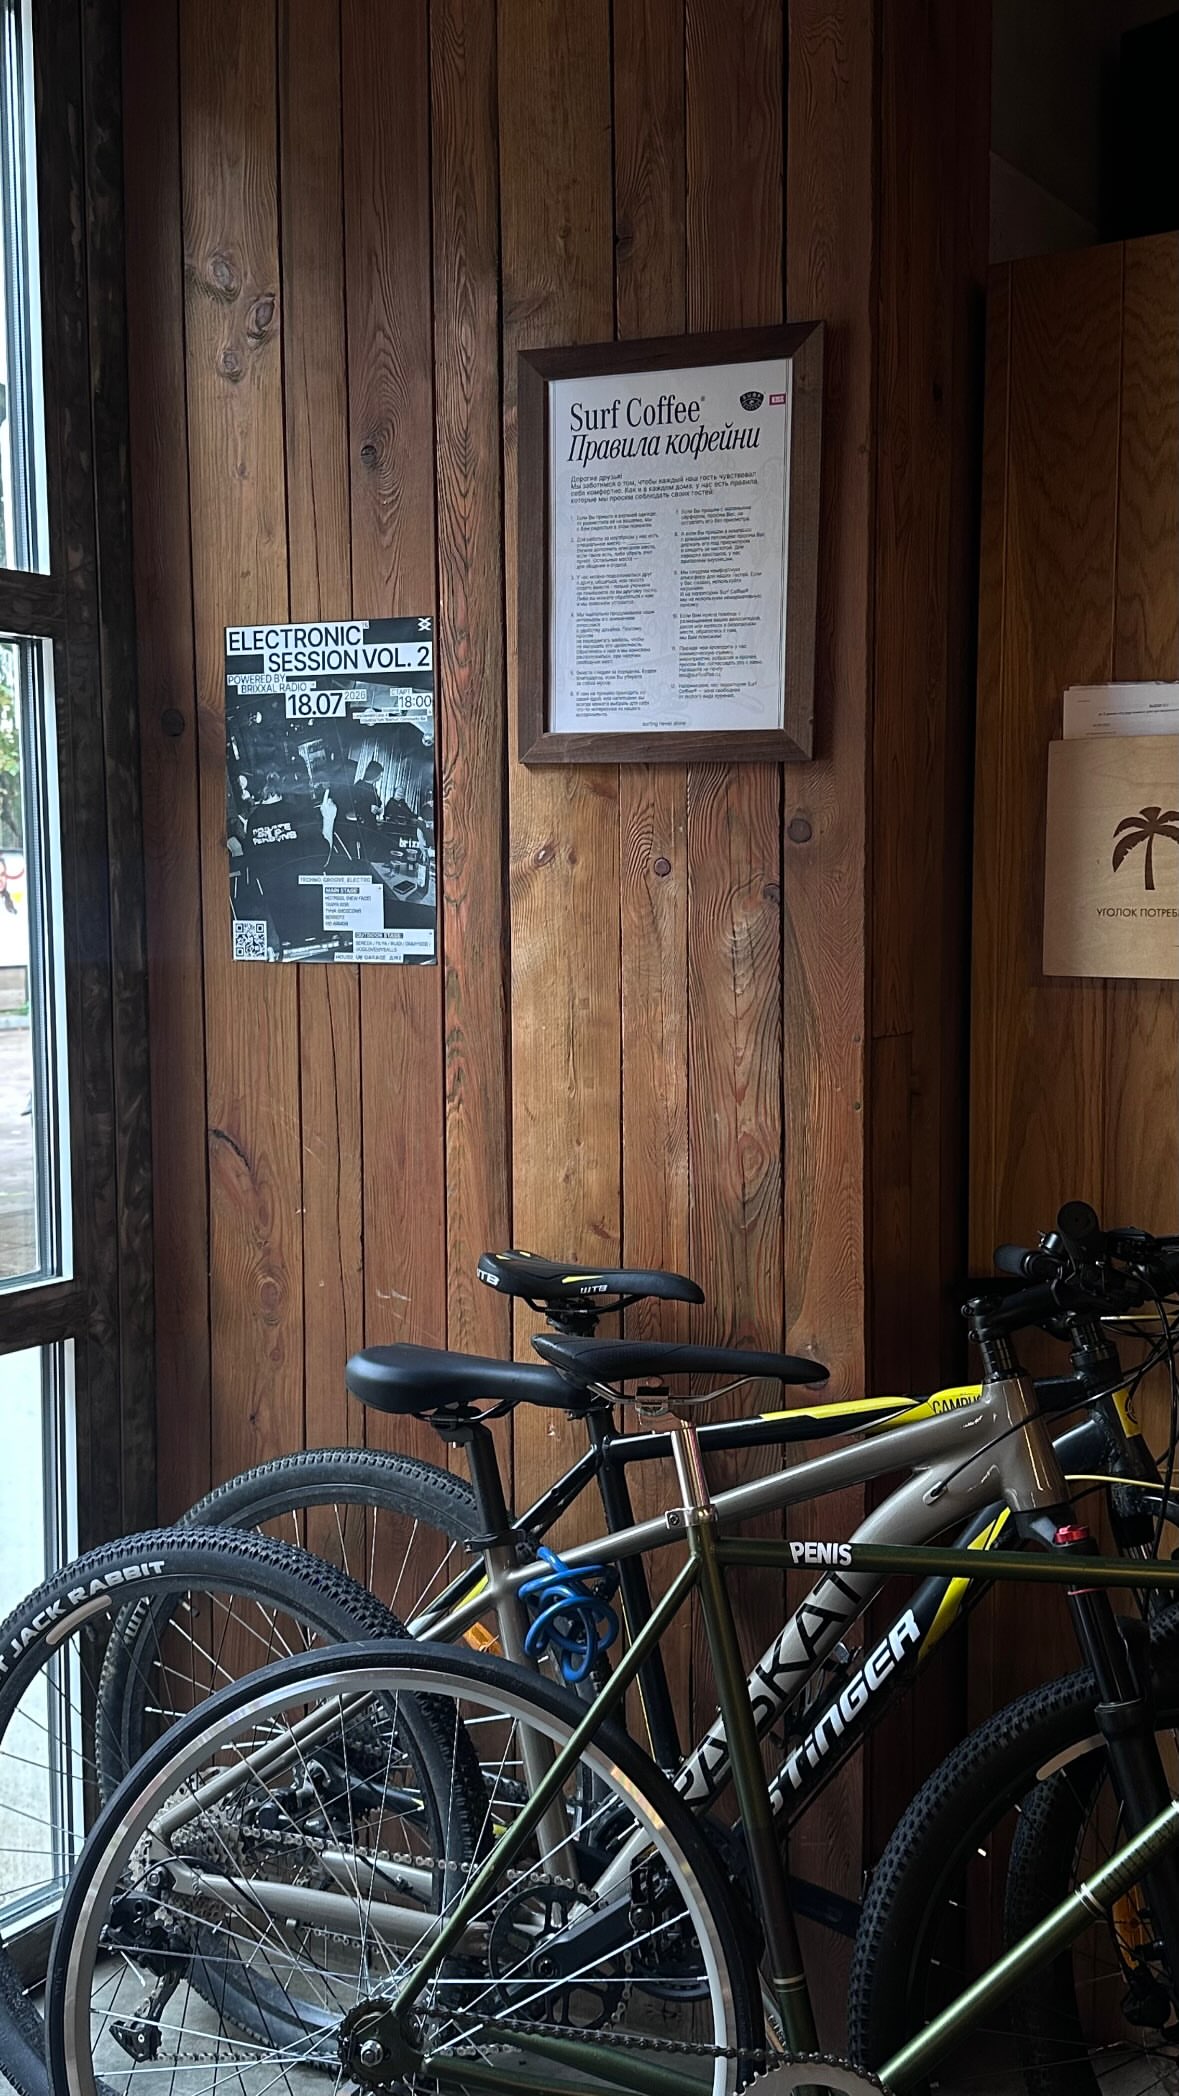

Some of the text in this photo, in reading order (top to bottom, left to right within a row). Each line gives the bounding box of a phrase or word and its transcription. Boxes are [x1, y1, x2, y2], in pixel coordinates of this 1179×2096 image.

[570, 399, 621, 432] Surf
[568, 421, 761, 468] Правила кофейни
[229, 625, 361, 651] ELECTRONIC
[268, 645, 430, 673] SESSION VOL. 2
[228, 674, 286, 685] POWERED BY
[241, 682, 307, 693] BRIXXAL RADIO
[287, 692, 343, 717] 18.07
[399, 695, 432, 708] 18:00
[1096, 907, 1179, 918] УГОЛОК ПОТРЕБ
[580, 1284, 608, 1295] WTB
[789, 1541, 853, 1566] PENIS
[11, 1599, 67, 1659] JACK
[67, 1560, 166, 1605] RABBIT
